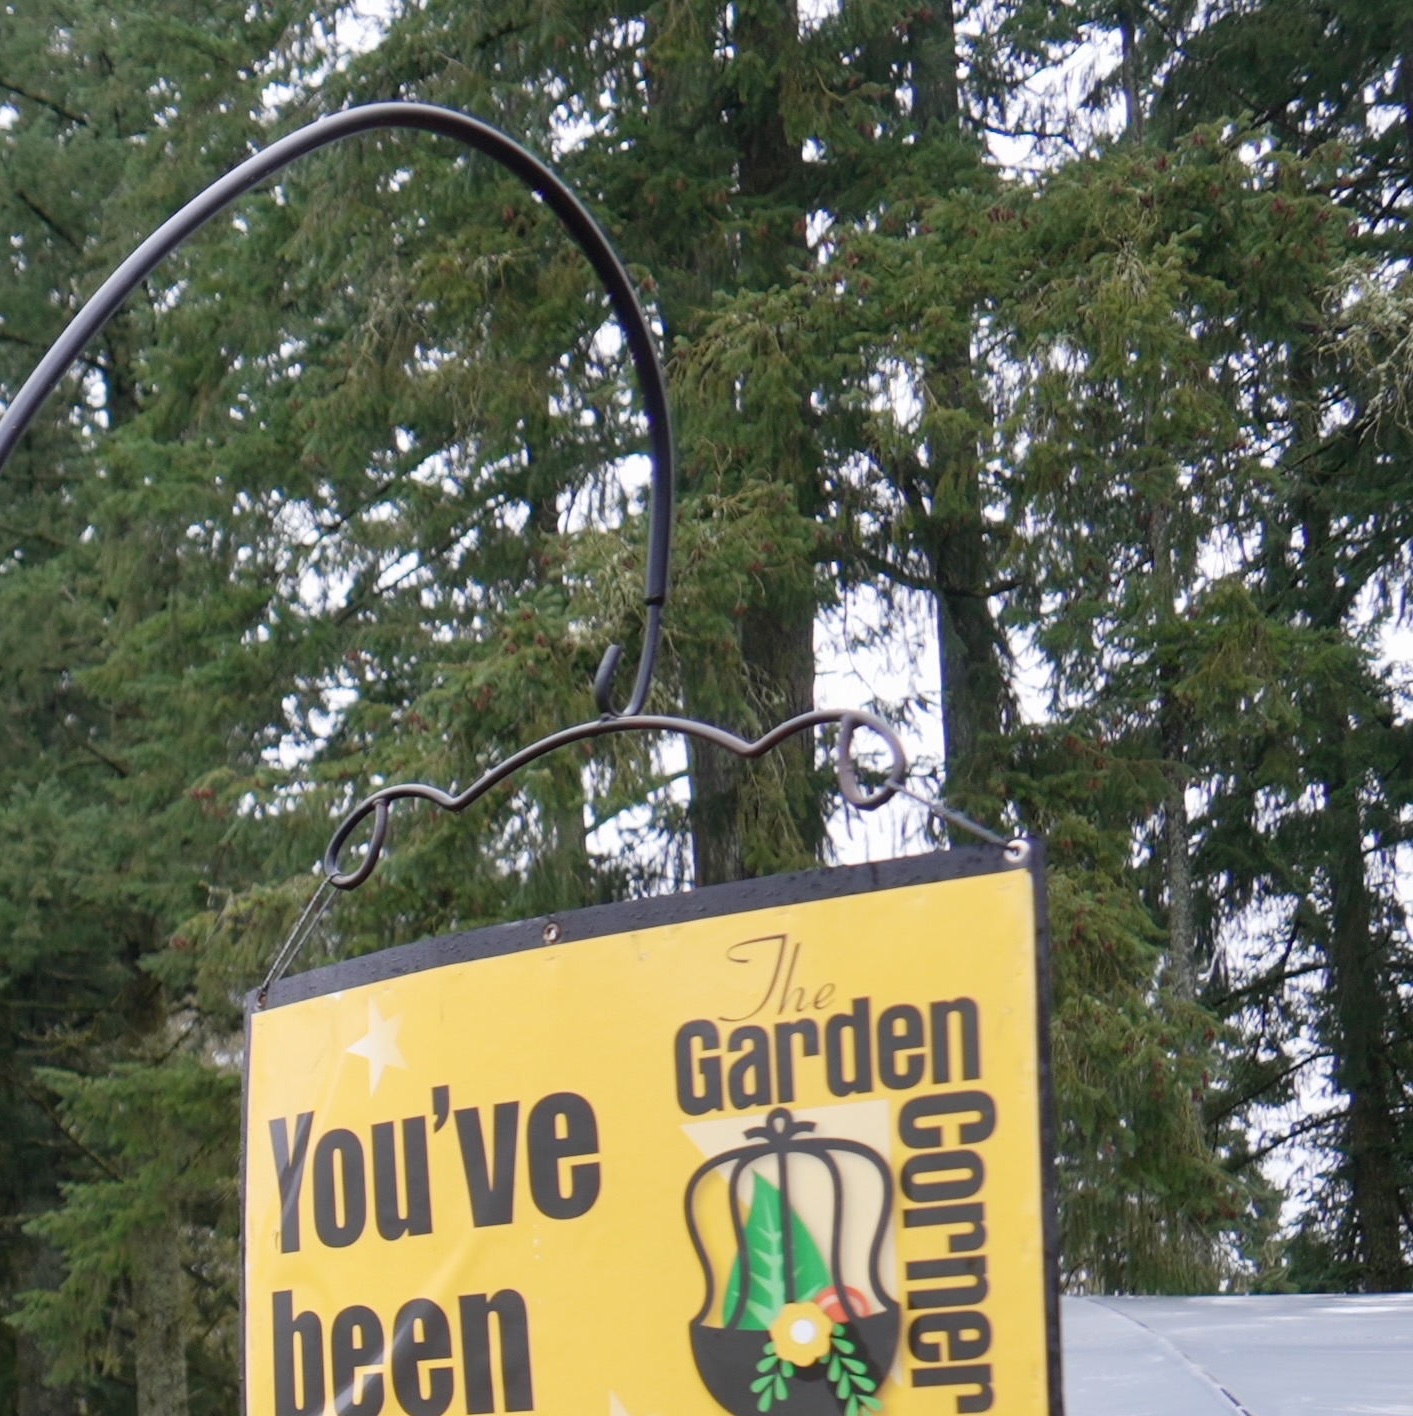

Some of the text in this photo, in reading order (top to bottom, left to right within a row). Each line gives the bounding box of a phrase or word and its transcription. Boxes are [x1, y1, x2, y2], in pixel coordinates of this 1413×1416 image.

[718, 933, 836, 1022] The
[674, 996, 981, 1116] Garden
[268, 1086, 602, 1255] You've
[898, 1089, 997, 1414] Corner
